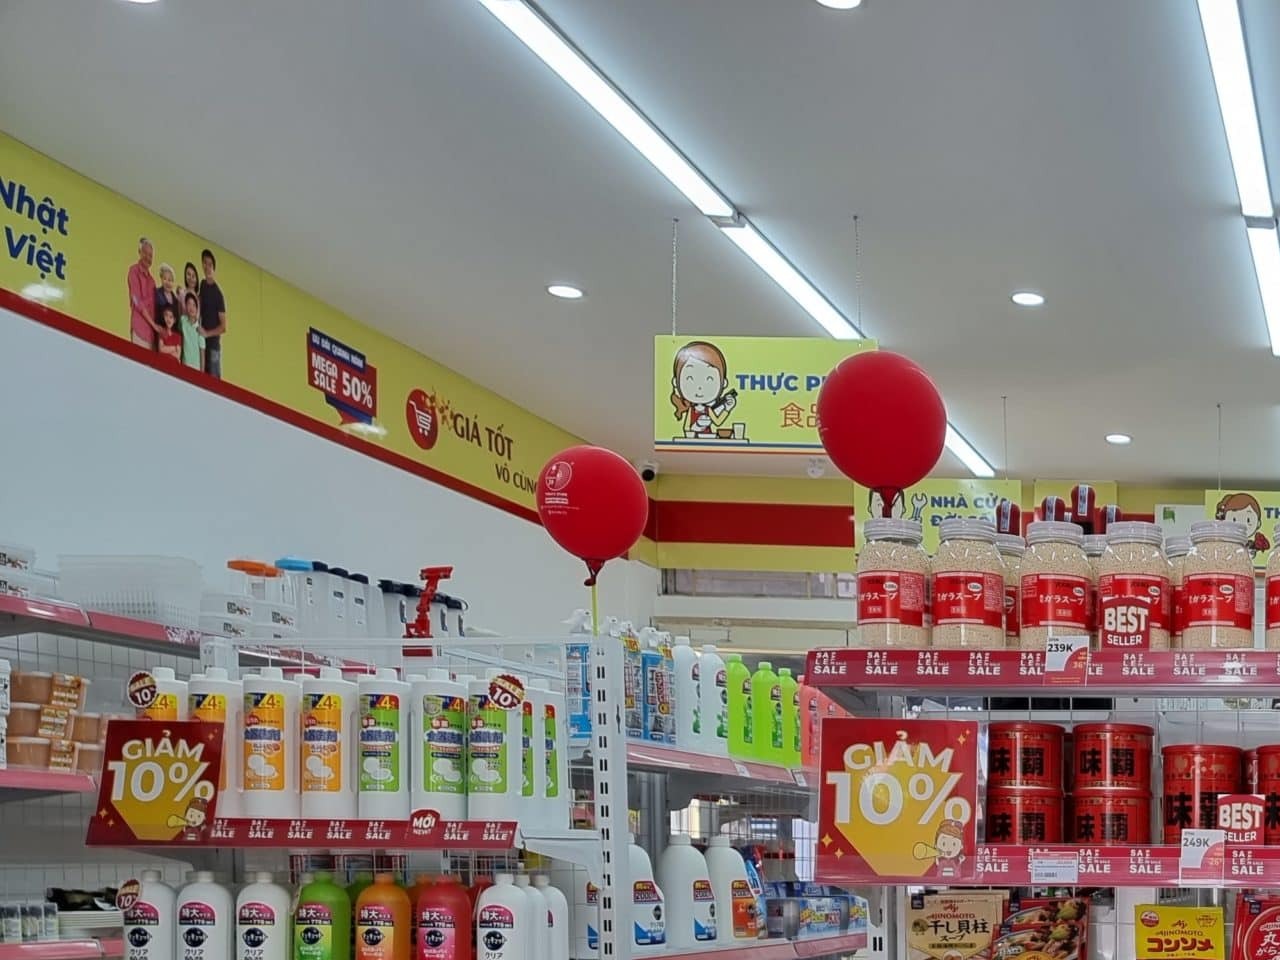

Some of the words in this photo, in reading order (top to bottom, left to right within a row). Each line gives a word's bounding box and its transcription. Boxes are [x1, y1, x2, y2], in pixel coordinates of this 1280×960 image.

[0, 176, 69, 236] Nhật
[5, 226, 66, 280] Việt
[312, 352, 338, 379] MEGA
[314, 370, 336, 394] SALE
[342, 371, 373, 408] 50%
[736, 372, 798, 395] THỰC
[453, 413, 482, 447] GIÁ
[485, 424, 513, 461] TỐT
[495, 463, 510, 483] VÔ
[931, 493, 968, 508] NHÀ
[1104, 607, 1149, 633] BEST
[1048, 644, 1073, 652] 239K
[1107, 634, 1143, 646] SELLER
[814, 666, 847, 675] SALE
[122, 729, 204, 762] GIẢM
[843, 730, 954, 773] GIẢM
[107, 760, 214, 802] 10%
[826, 771, 971, 825] 10%
[412, 813, 435, 828] MỚI
[1219, 803, 1264, 829] BEST
[248, 830, 273, 839] SALE
[1183, 838, 1210, 848] 249K
[976, 863, 1009, 872] SALE
[1232, 865, 1264, 875] SALE
[928, 919, 989, 933] 干し貝柱
[940, 934, 967, 943] スープ
[1147, 938, 1214, 953] コンソメ
